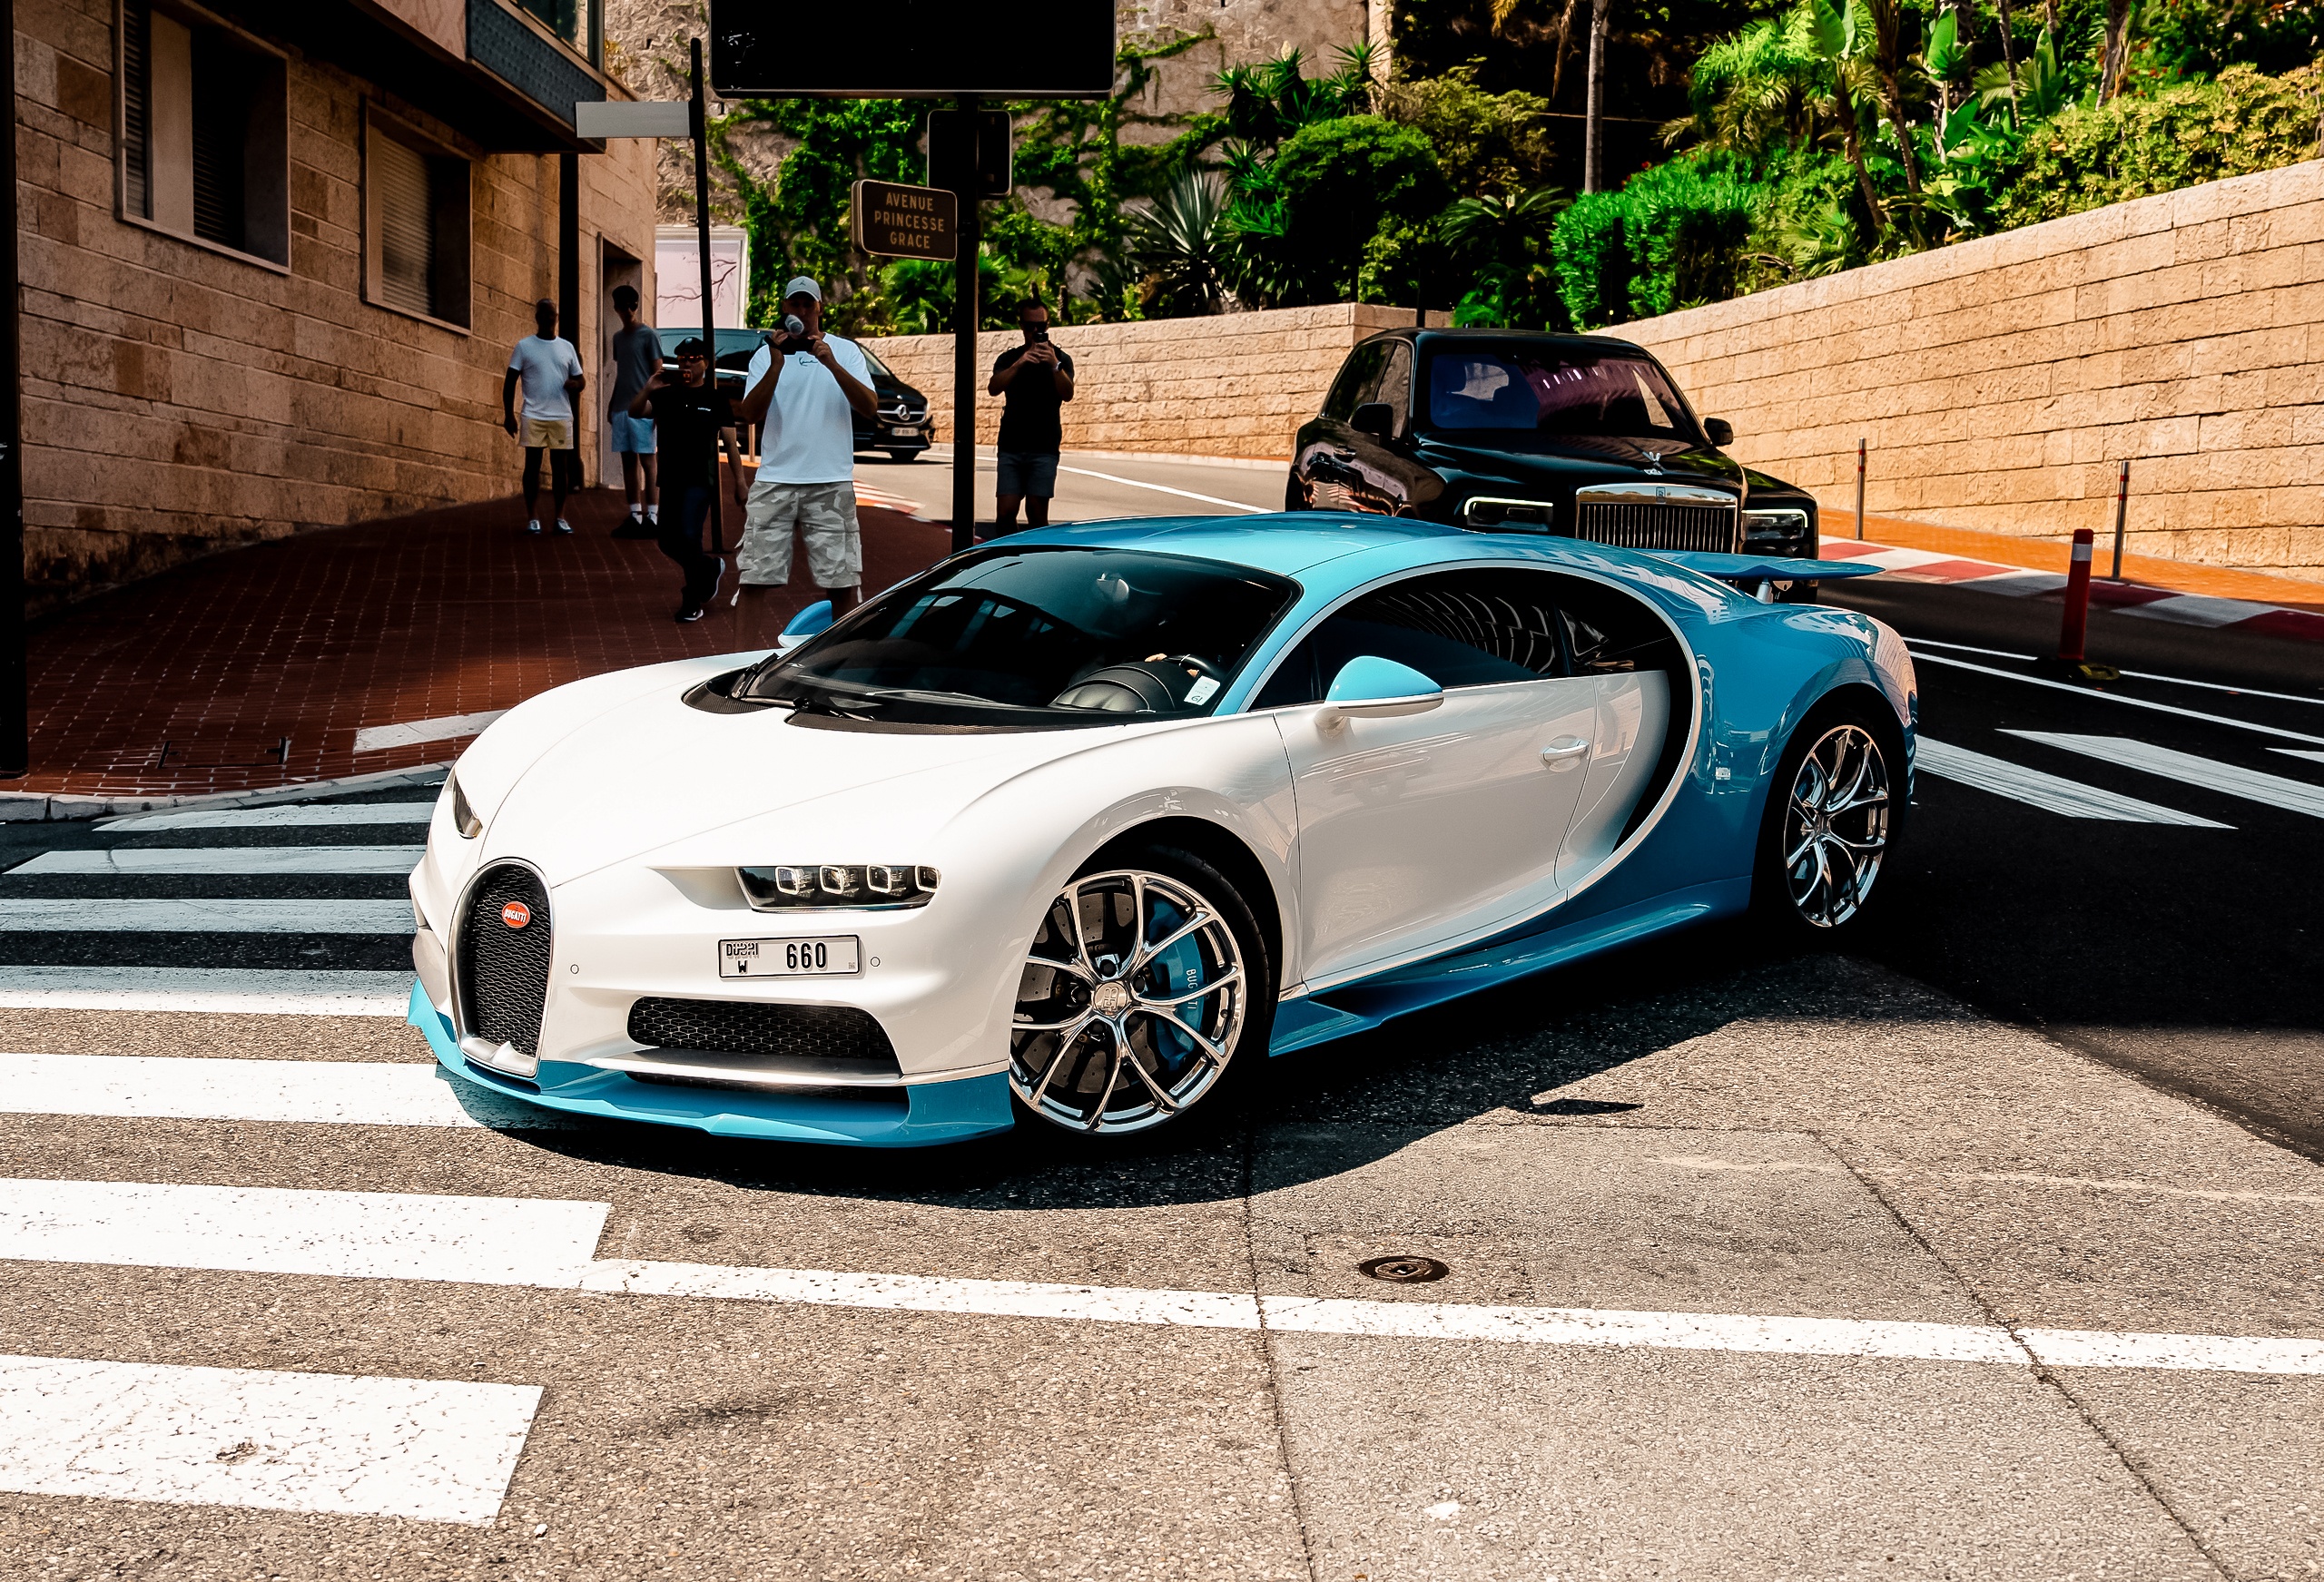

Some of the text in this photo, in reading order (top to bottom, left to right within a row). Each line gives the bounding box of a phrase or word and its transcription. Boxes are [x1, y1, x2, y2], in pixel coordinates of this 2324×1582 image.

[886, 192, 934, 211] AVENUE
[874, 211, 945, 232] PRINCESSE
[890, 231, 931, 250] GRACE
[786, 942, 826, 968] 660
[737, 959, 747, 973] W
[1186, 968, 1198, 1009] BUGTI
